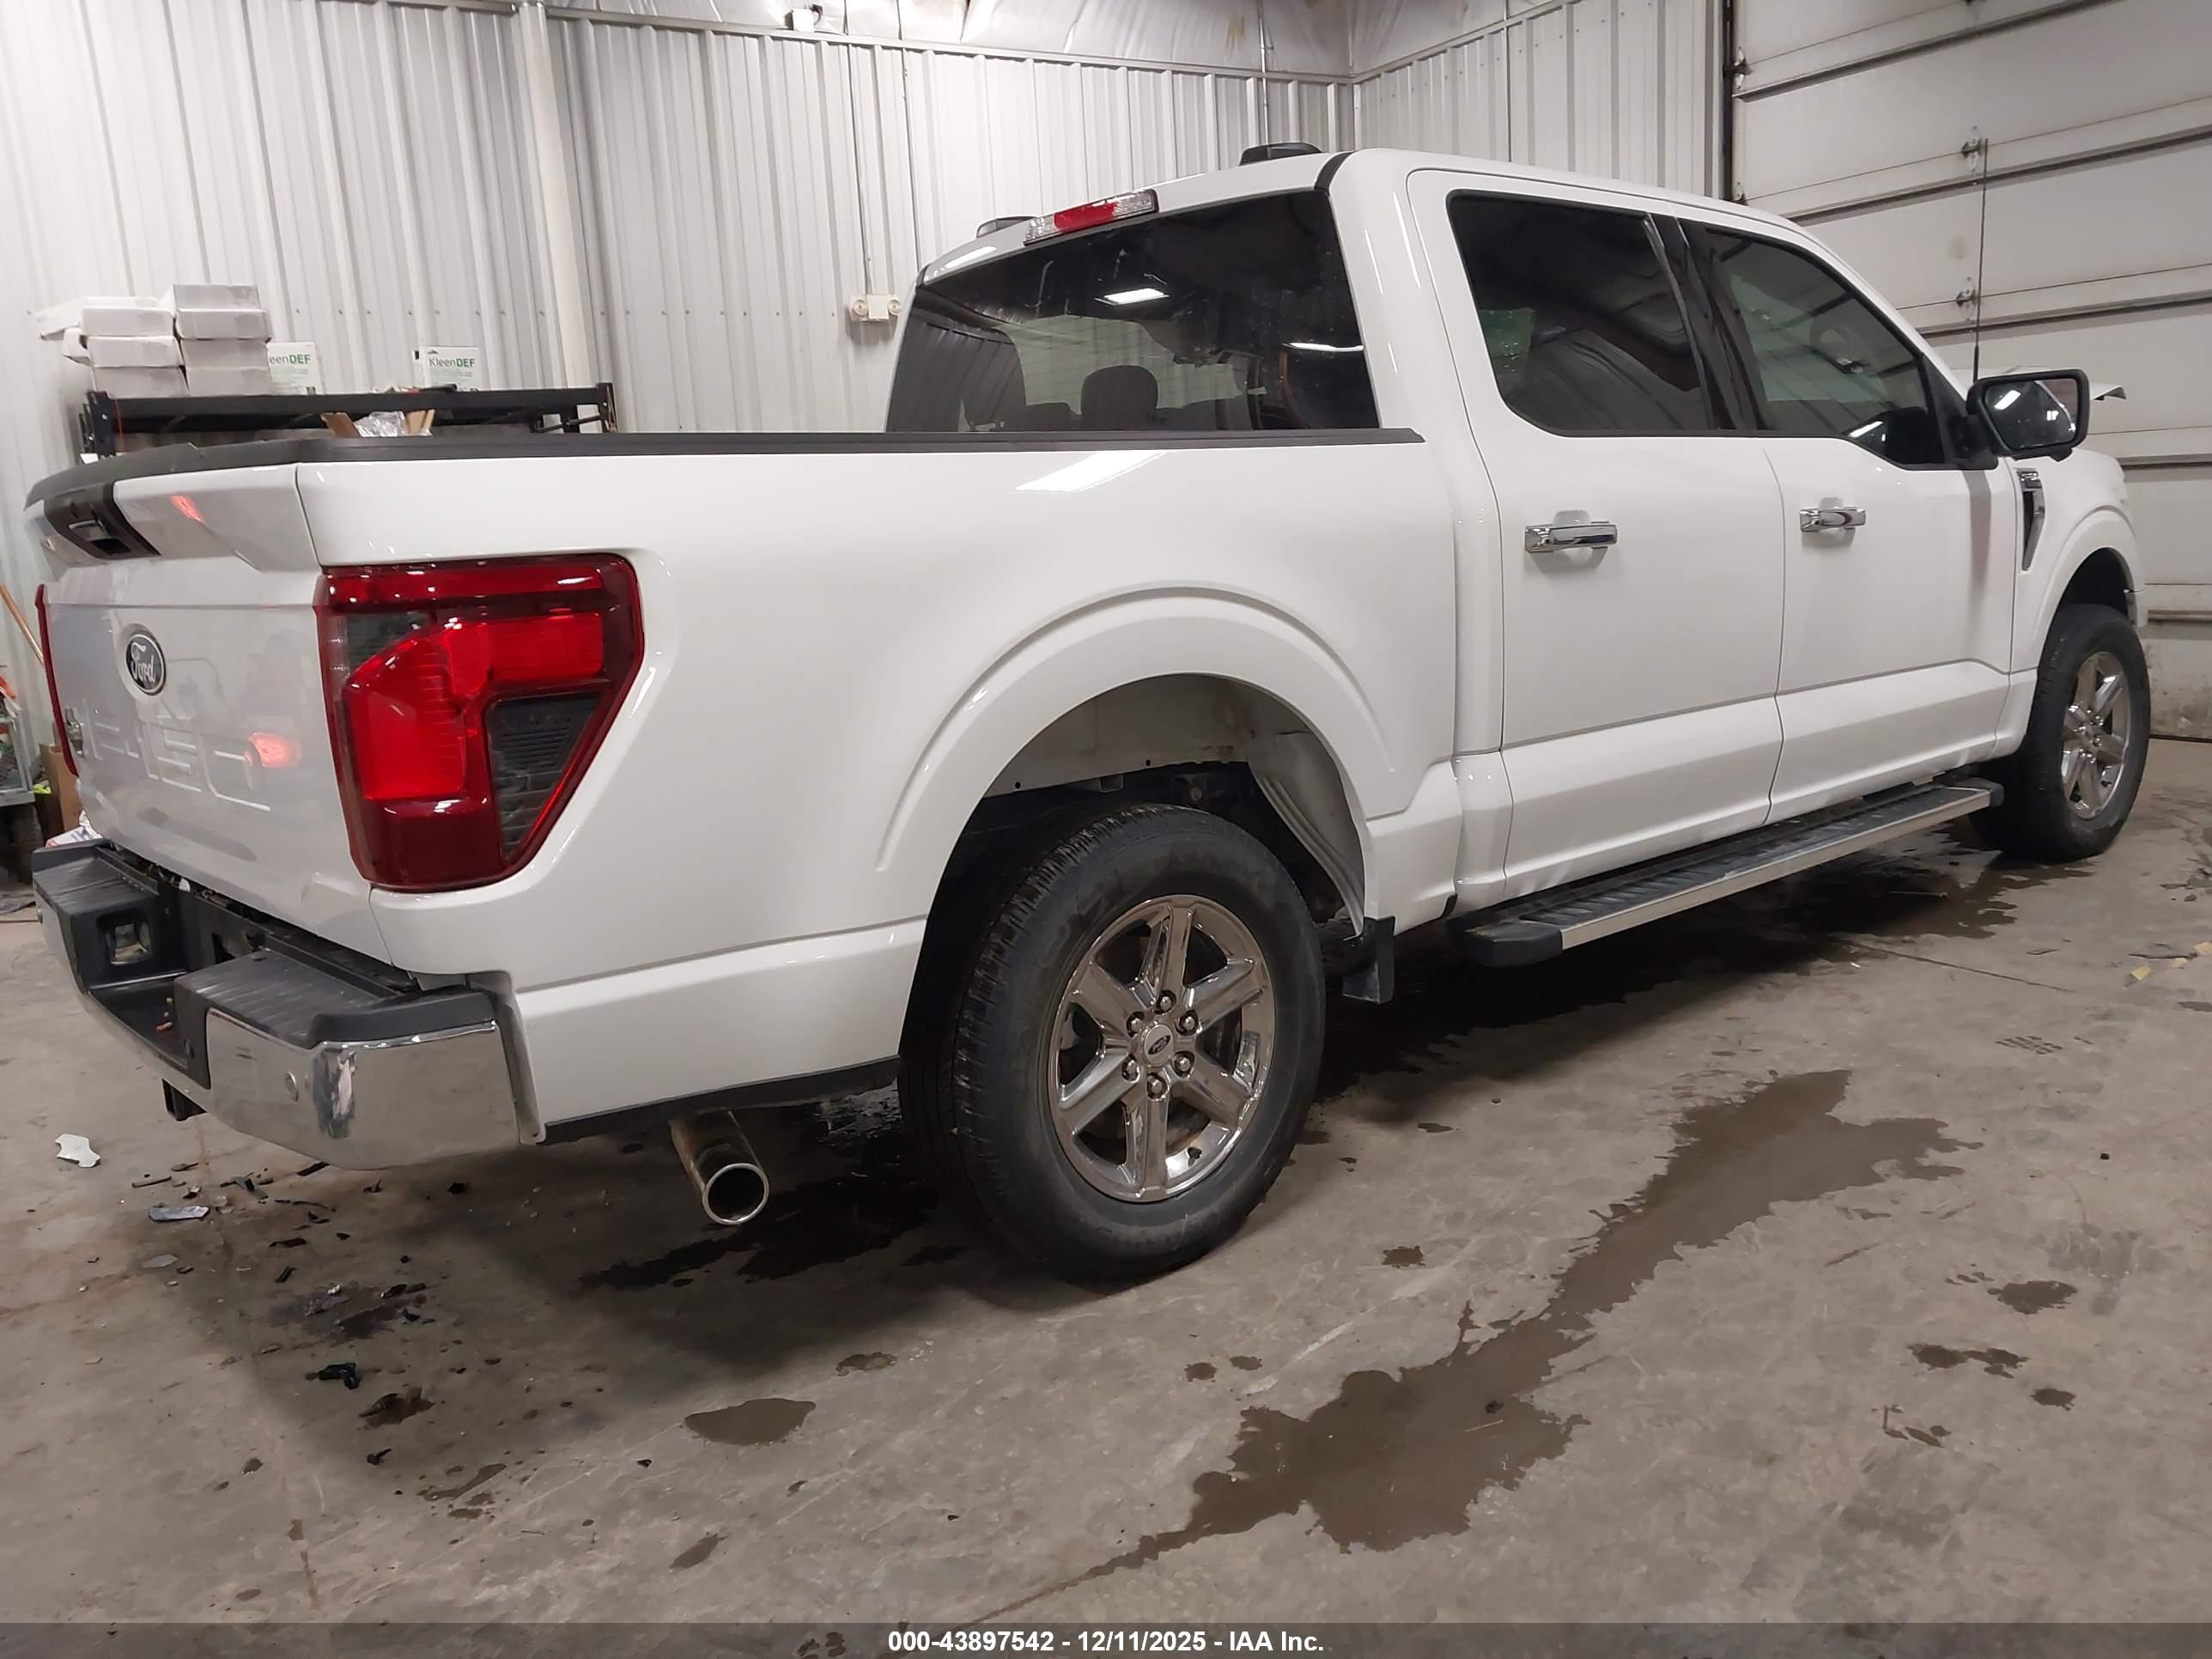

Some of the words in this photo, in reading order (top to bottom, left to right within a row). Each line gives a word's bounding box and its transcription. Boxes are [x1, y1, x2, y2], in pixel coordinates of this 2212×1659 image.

[269, 354, 311, 365] eenDEF
[429, 356, 476, 368] KleenDEF
[131, 641, 156, 683] Ford
